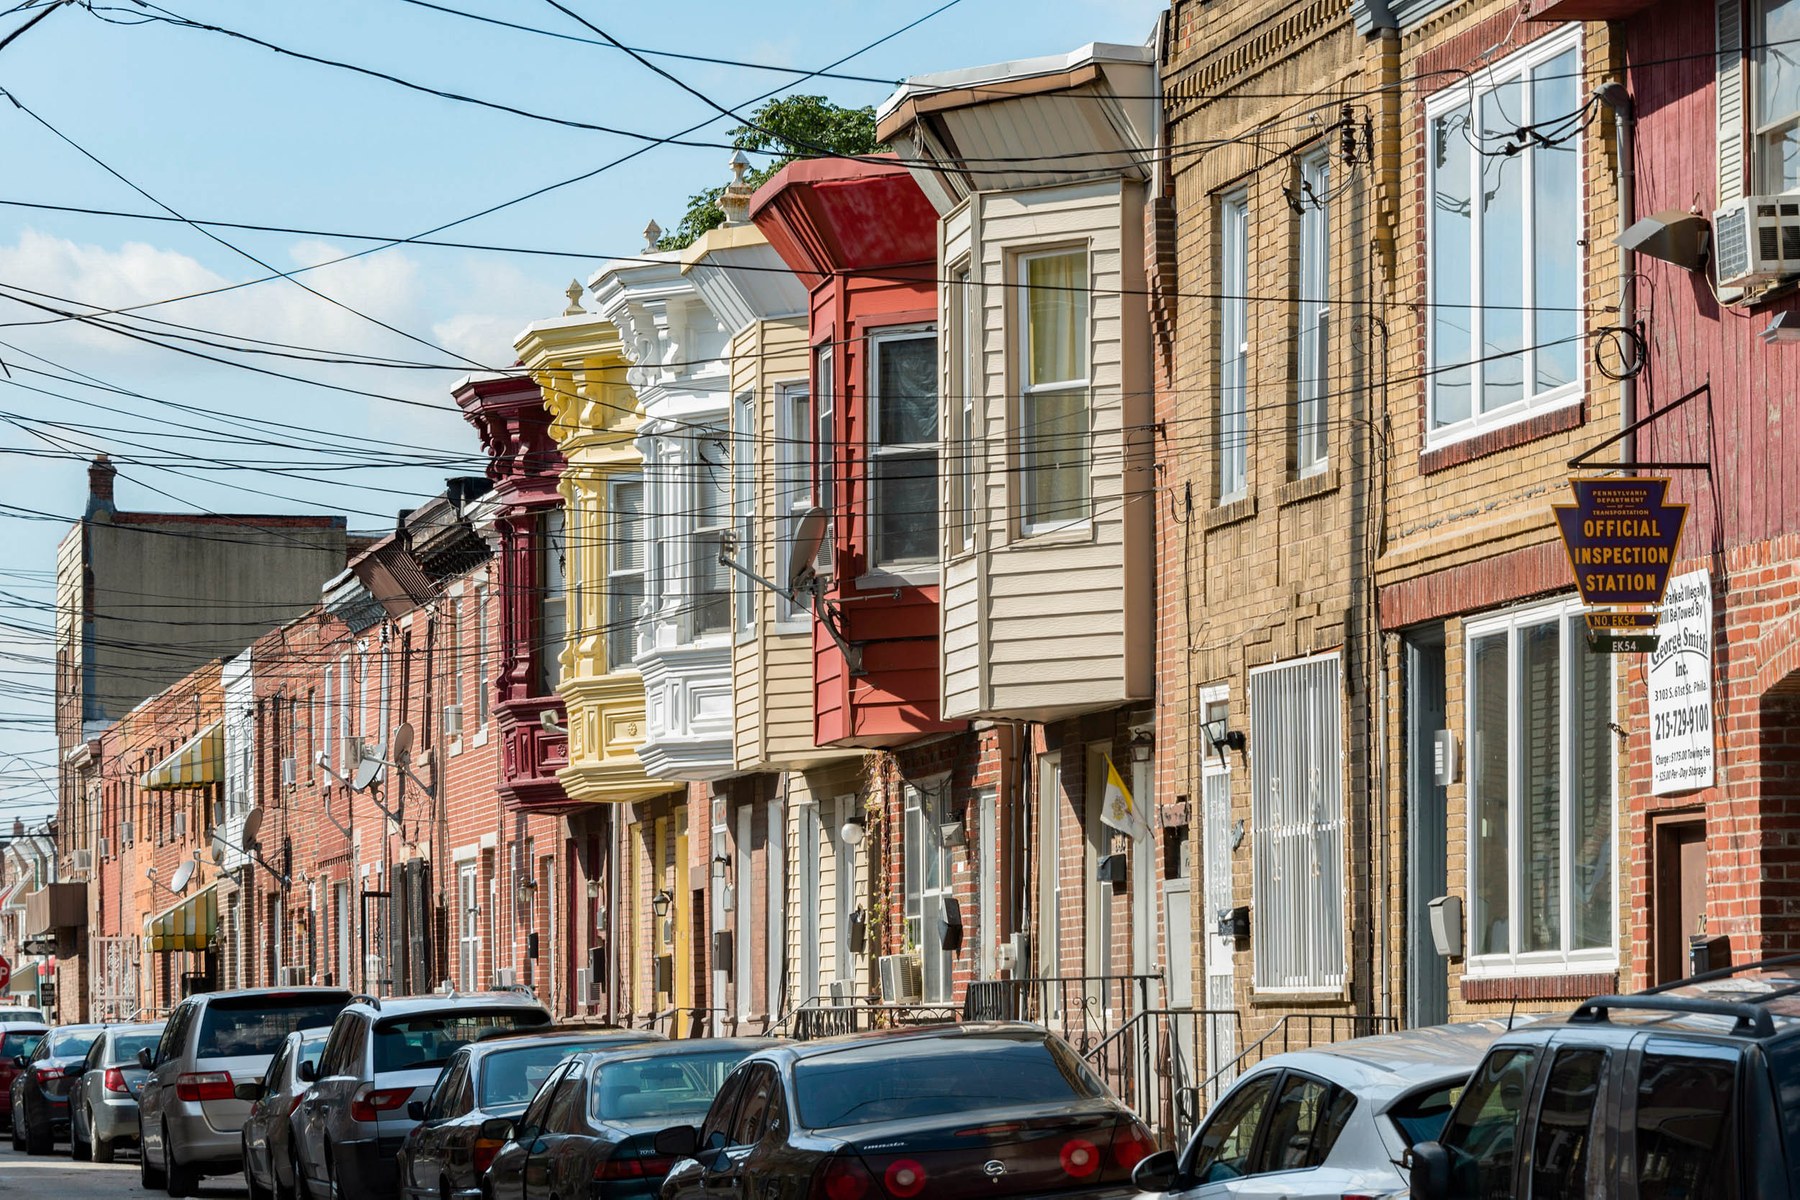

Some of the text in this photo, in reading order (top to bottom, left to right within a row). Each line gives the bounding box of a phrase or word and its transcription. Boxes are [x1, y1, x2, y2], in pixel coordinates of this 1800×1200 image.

[1583, 519, 1661, 538] OFFICIAL
[1574, 547, 1669, 565] INSPECTION
[1585, 574, 1656, 592] STATION
[1670, 608, 1678, 622] Be
[1678, 602, 1694, 620] Towed
[1695, 601, 1702, 618] By
[1594, 615, 1636, 626] NO. EK54
[1612, 641, 1637, 652] EK54
[1651, 627, 1708, 665] George Smith
[1675, 661, 1689, 677] Inc.
[1655, 688, 1669, 701] 3103
[1655, 703, 1709, 740] 215-729-9100
[1687, 748, 1703, 760] Towing
[1689, 765, 1707, 778] Storage
